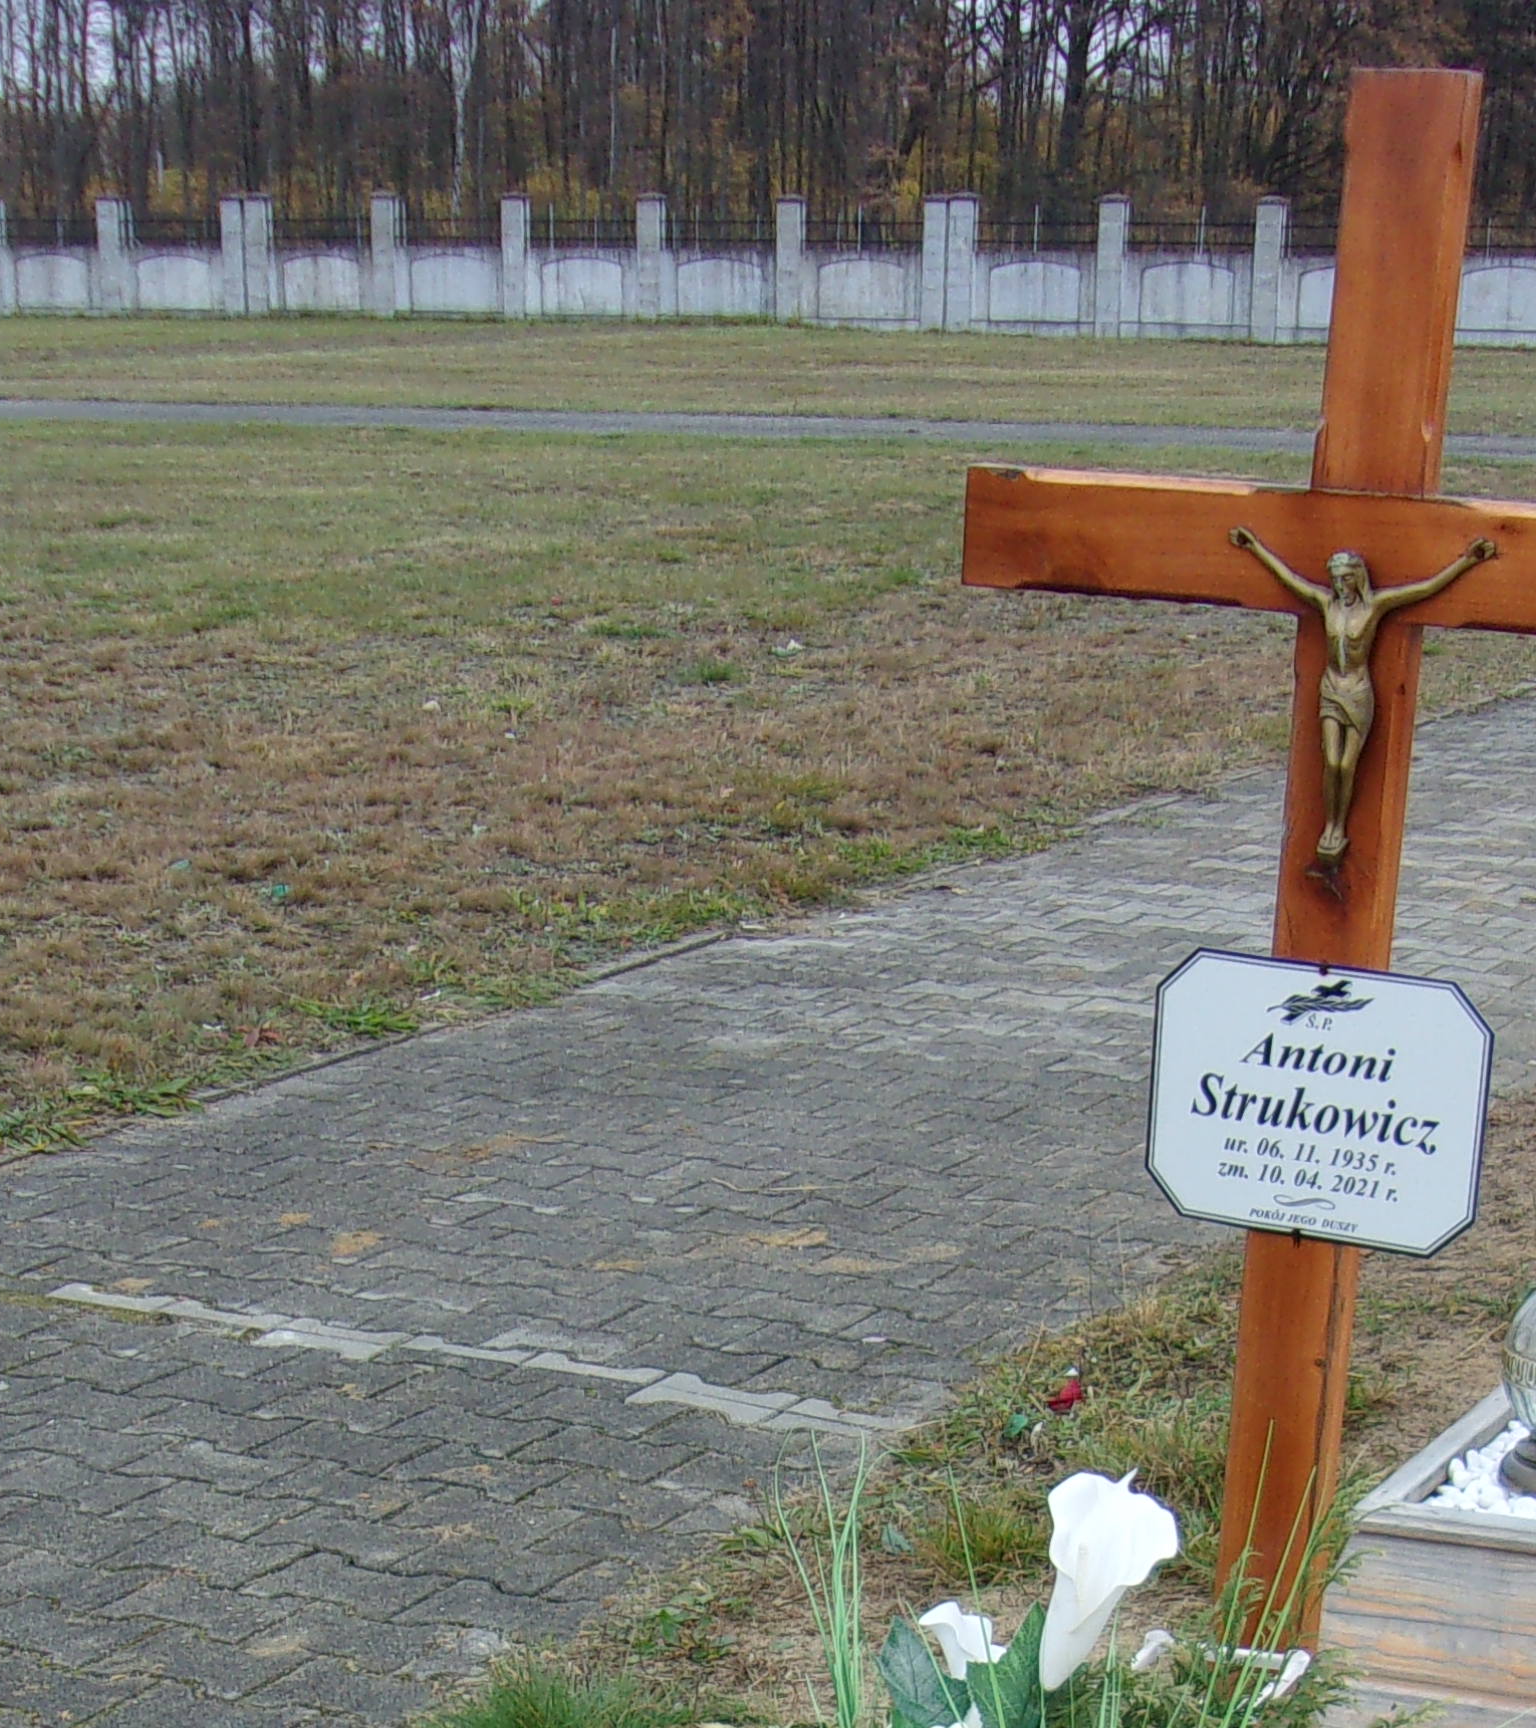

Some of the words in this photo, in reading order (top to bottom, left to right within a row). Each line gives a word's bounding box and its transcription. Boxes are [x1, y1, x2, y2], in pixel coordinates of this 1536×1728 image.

[1240, 1032, 1397, 1082] Antoni
[1190, 1072, 1441, 1156] Strukowicz
[1224, 1137, 1249, 1154] ur.
[1256, 1137, 1285, 1160] 06.
[1293, 1142, 1321, 1165] 11.
[1329, 1148, 1380, 1173] 1935
[1383, 1161, 1397, 1176] r.
[1217, 1162, 1249, 1180] zm.
[1258, 1163, 1285, 1185] 10.
[1294, 1168, 1323, 1191] 04.
[1330, 1174, 1381, 1199] 2021
[1384, 1187, 1399, 1202] r.
[1249, 1207, 1286, 1222] POKÓJ
[1287, 1213, 1318, 1226] JEGO
[1321, 1218, 1359, 1233] DUSZY
